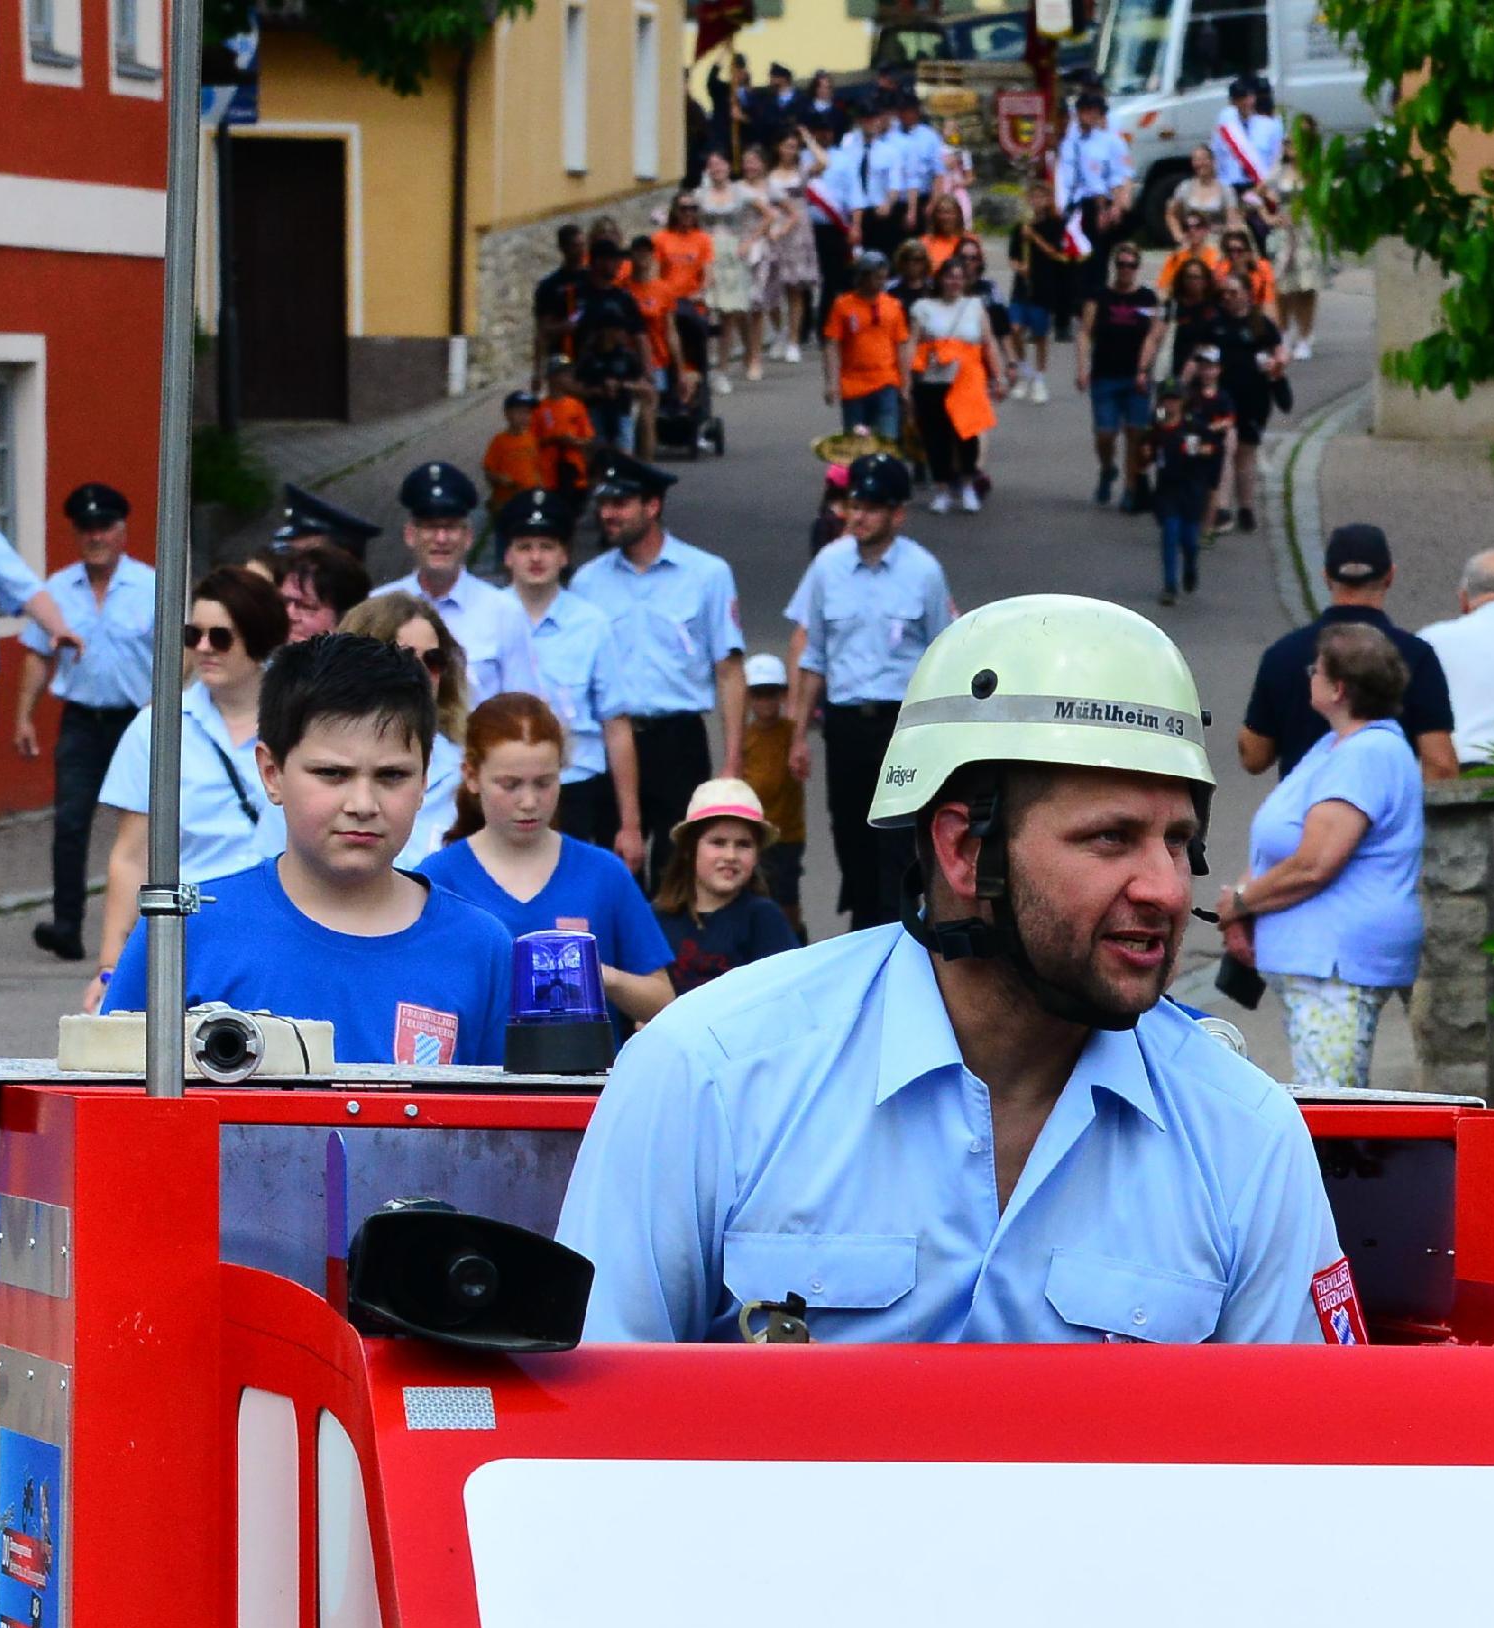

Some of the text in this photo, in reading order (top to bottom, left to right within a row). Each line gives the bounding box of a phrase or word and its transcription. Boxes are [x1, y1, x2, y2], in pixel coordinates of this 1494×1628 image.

[1054, 700, 1185, 737] Mühlheim 43
[886, 765, 918, 787] Dräger
